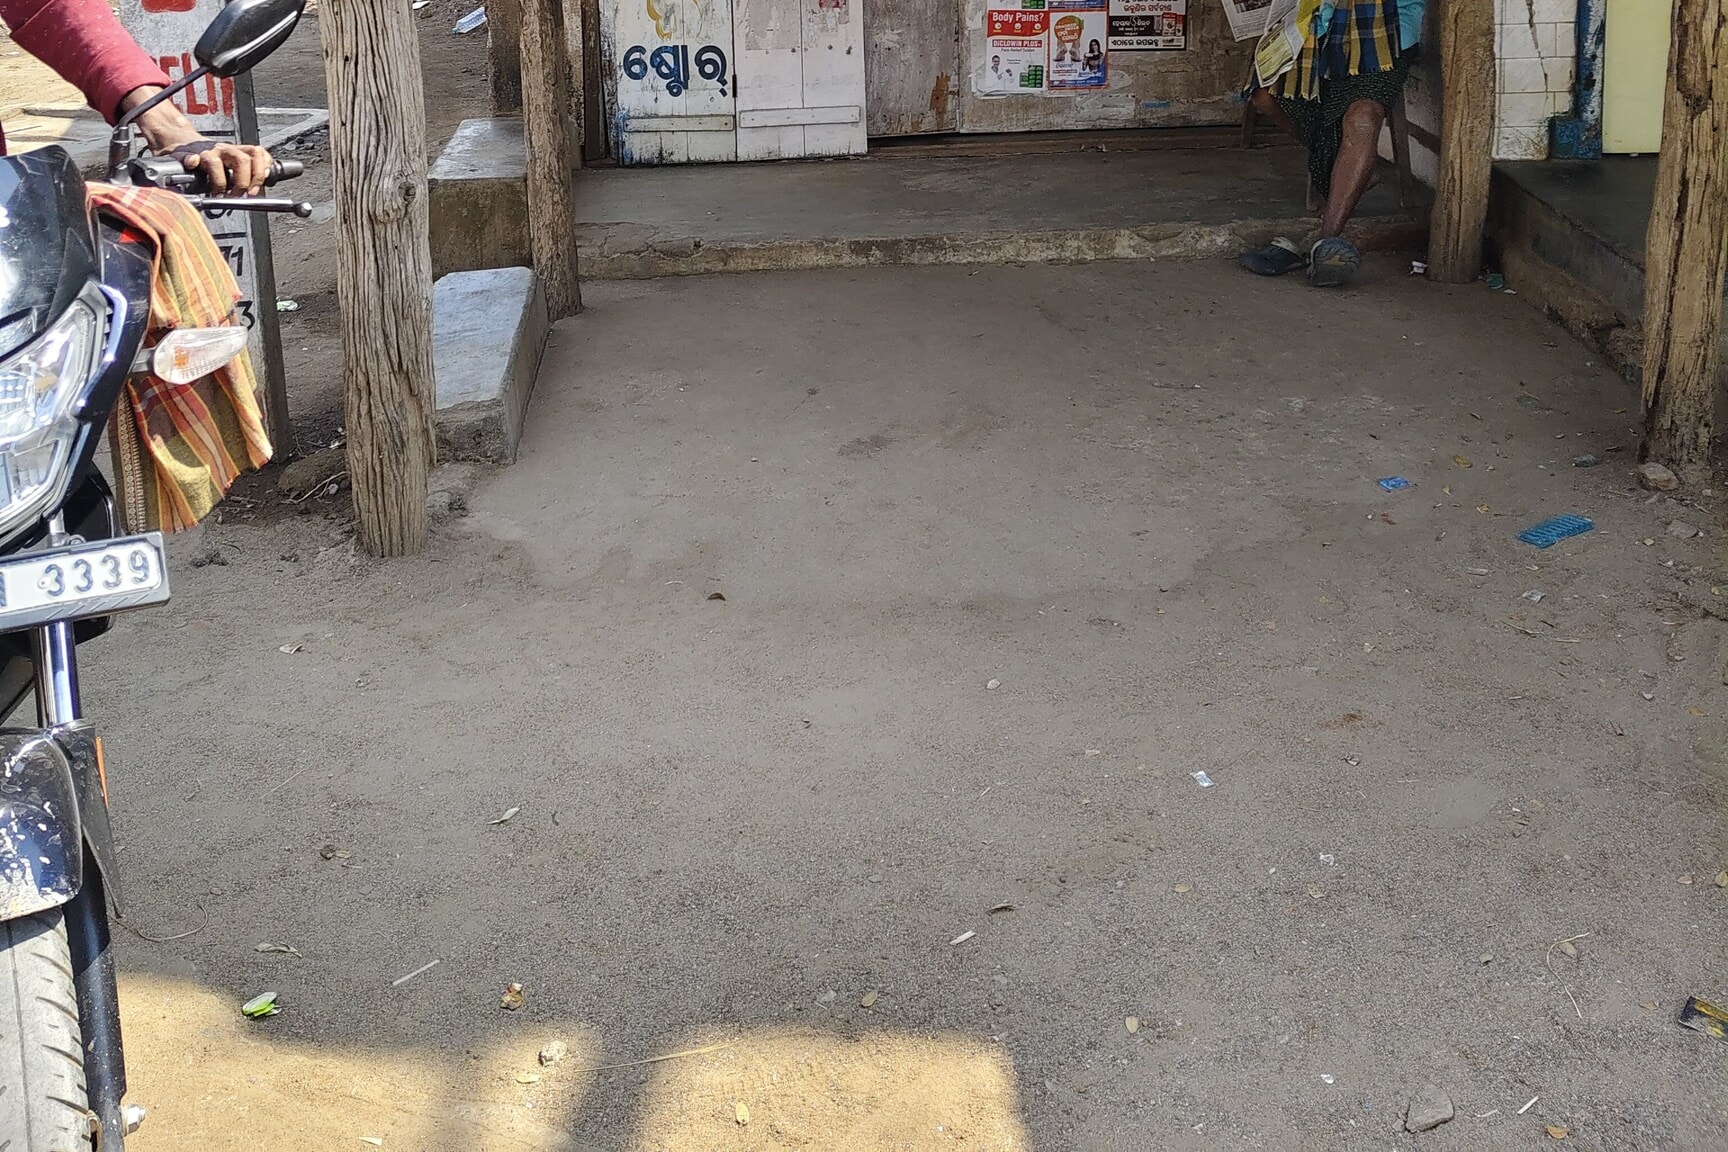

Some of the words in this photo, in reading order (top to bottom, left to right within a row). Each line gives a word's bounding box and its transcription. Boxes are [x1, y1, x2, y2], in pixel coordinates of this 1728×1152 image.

[993, 13, 1013, 23] Body
[1016, 12, 1044, 22] Pains?
[44, 549, 150, 597] 3339
